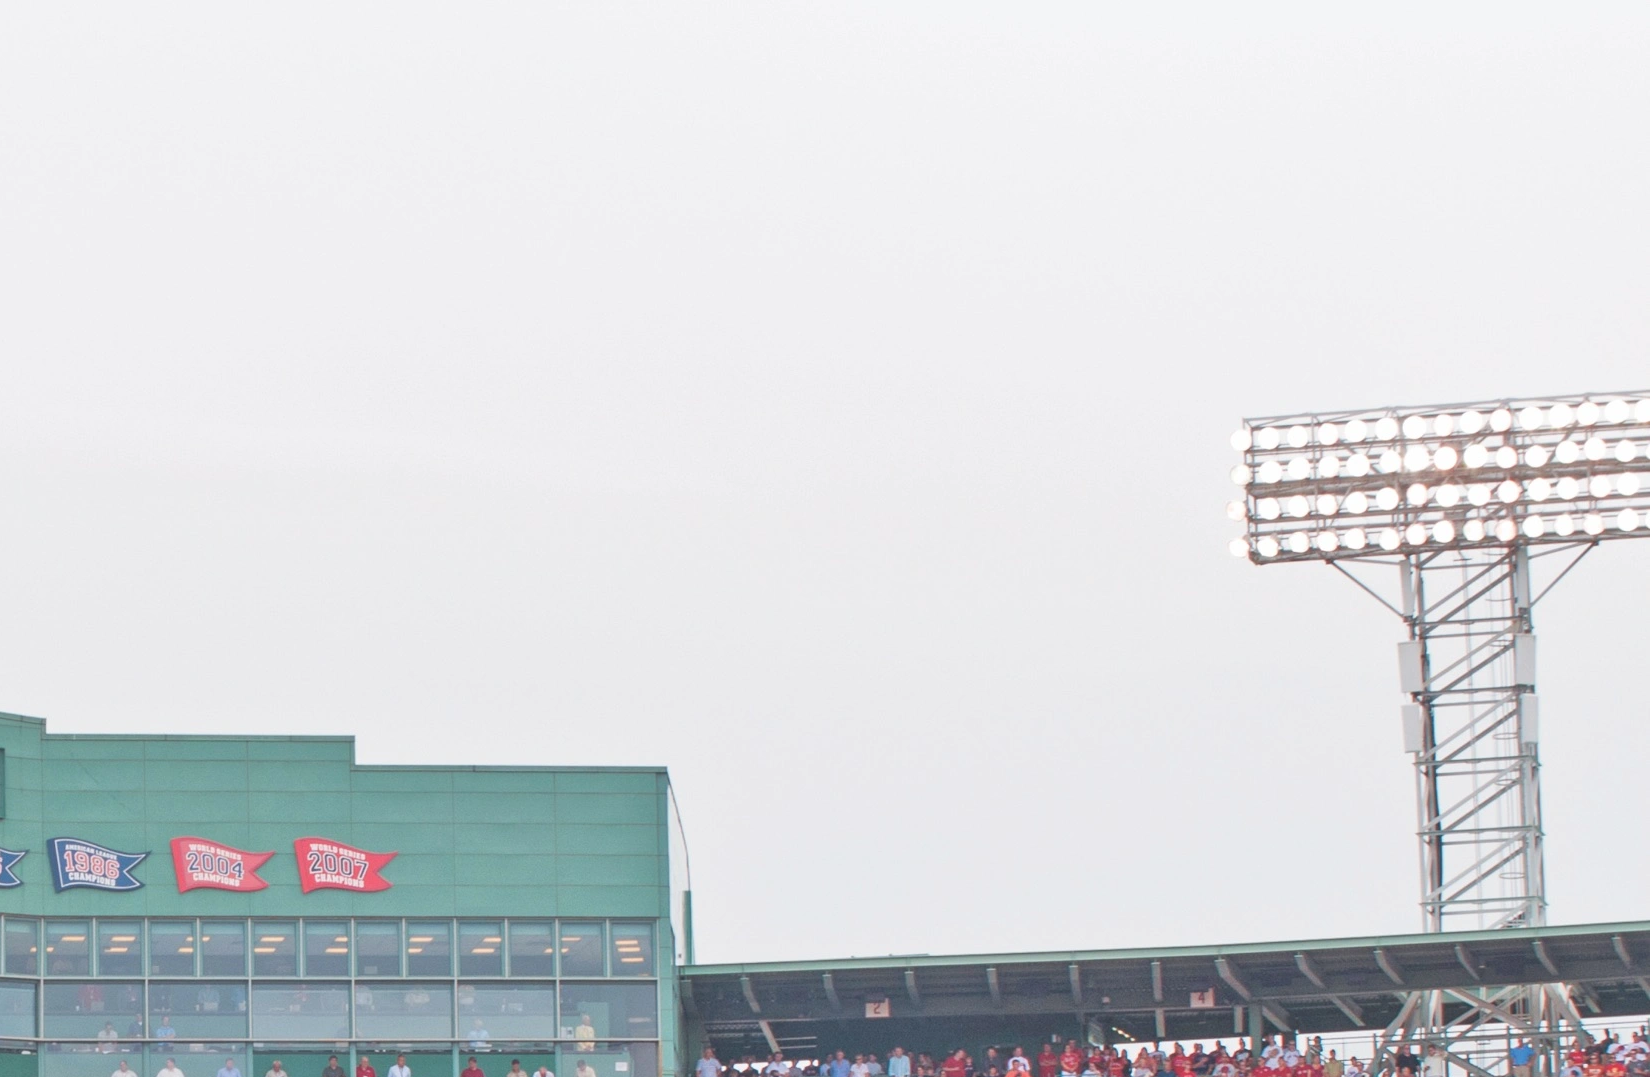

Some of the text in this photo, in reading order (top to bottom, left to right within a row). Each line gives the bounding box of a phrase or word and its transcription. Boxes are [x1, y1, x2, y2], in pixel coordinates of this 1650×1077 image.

[65, 844, 95, 855] AMERICAN
[188, 843, 242, 861] WORLD SERIES
[309, 843, 366, 861] WORLD SERIES
[63, 850, 120, 880] 1986
[186, 851, 244, 879] 2004
[307, 851, 368, 880] 2007
[68, 871, 117, 887] CHAMPIONS
[192, 872, 240, 887] CHAMPIONS
[314, 872, 365, 889] CHAMPIONS
